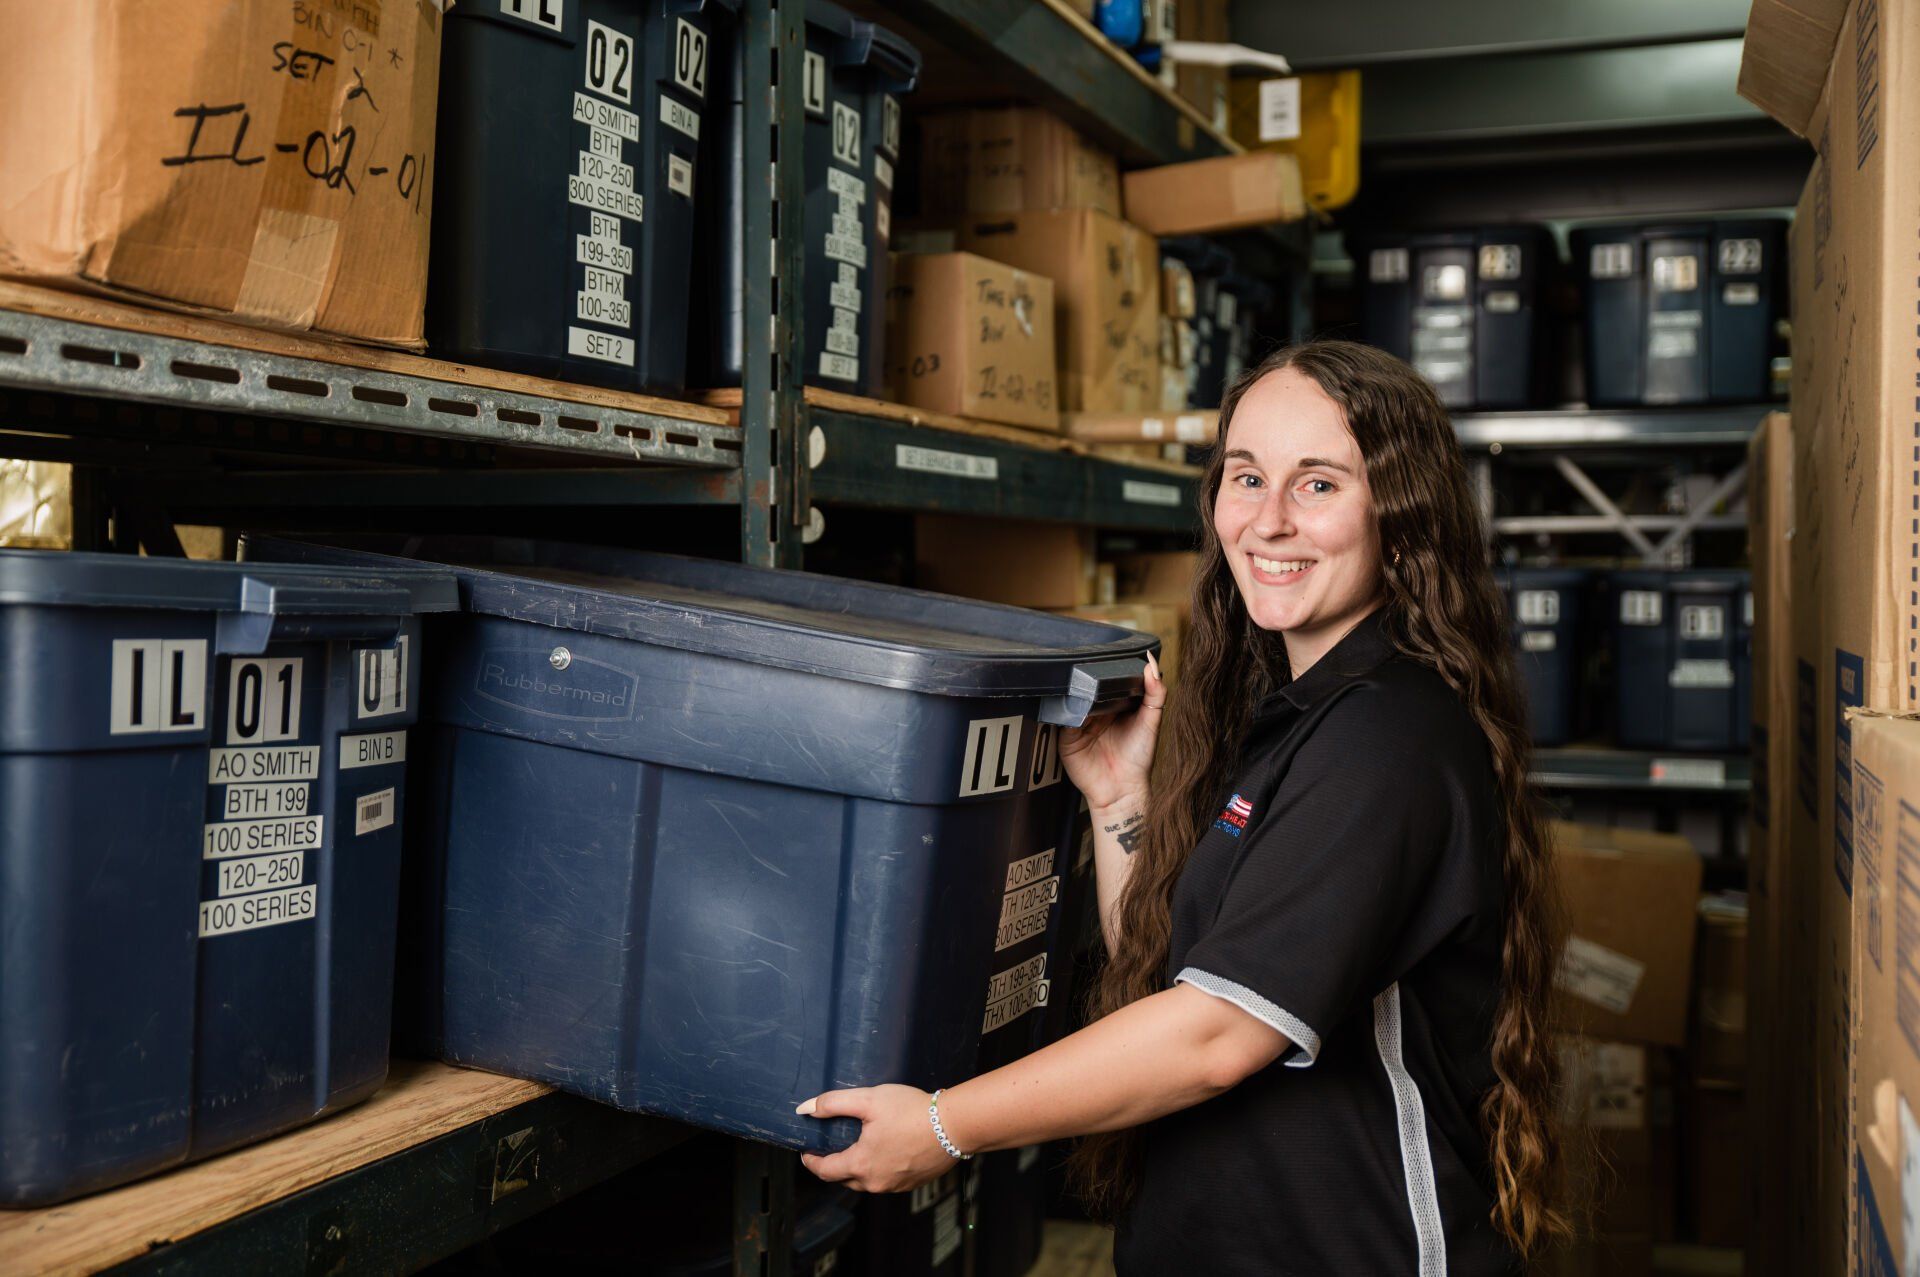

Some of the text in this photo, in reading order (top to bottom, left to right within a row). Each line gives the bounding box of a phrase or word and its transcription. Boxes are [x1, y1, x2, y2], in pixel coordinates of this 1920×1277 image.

[272, 42, 335, 82] SET
[589, 28, 629, 98] 02
[678, 25, 703, 90] 02
[575, 97, 637, 137] AO SMITH
[672, 105, 692, 131] BIN A
[593, 131, 619, 158] BTH
[836, 108, 857, 161] 02
[581, 156, 632, 188] 120-250
[569, 179, 642, 217] 300 SERIES
[593, 216, 618, 240] BTH
[581, 240, 631, 270] 199-350
[588, 271, 622, 296] BTHX
[579, 296, 629, 323] 100-350
[586, 334, 623, 359] SET 2
[130, 648, 194, 726] IL
[363, 638, 405, 712] 01
[483, 663, 627, 707] Rubbermaid
[235, 663, 293, 738] 01
[216, 751, 311, 777] AO SMITH
[359, 737, 393, 761] BIN B
[971, 724, 1009, 790] IL
[228, 787, 306, 813] BTH 199
[207, 820, 317, 854] 100 SERIES
[223, 857, 299, 890] 120-250
[1007, 854, 1053, 887] AO SMITH
[202, 890, 311, 931] 100 SERIES
[1002, 895, 1018, 918] TH
[1014, 908, 1049, 939] SERIES
[984, 1002, 1006, 1028] THX
